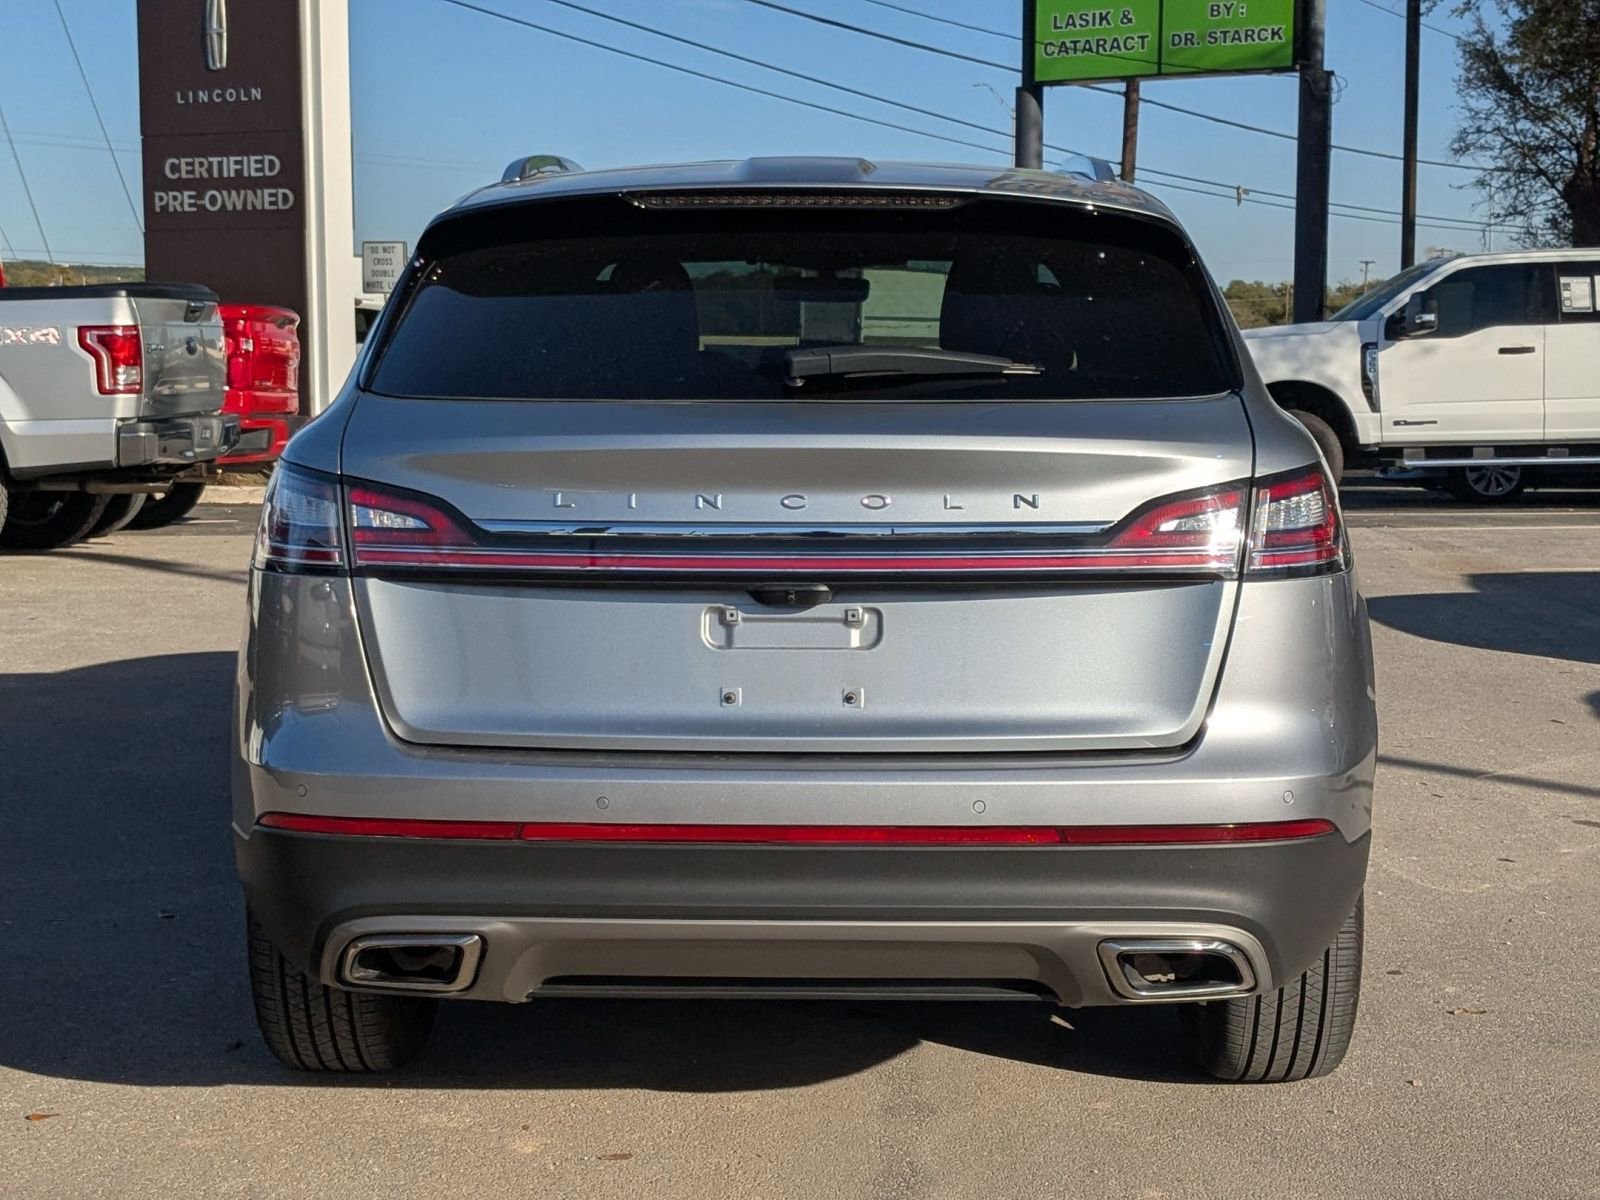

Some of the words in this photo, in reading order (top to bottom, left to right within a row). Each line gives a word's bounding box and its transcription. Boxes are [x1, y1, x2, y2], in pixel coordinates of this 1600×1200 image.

[1053, 10, 1113, 31] LASIK
[1119, 9, 1134, 25] &
[1043, 34, 1150, 57] CATARACT
[1170, 31, 1201, 48] DR.
[1207, 26, 1284, 46] STARCK
[176, 87, 263, 104] LINCOLN
[164, 154, 281, 180] CERTIFIED
[154, 188, 295, 213] PRE-OWNED
[370, 246, 379, 254] DO
[382, 246, 396, 254] NOT
[373, 258, 393, 266] CROSS
[371, 269, 395, 278] DOUBLE
[553, 491, 1040, 510] LINCOLN
